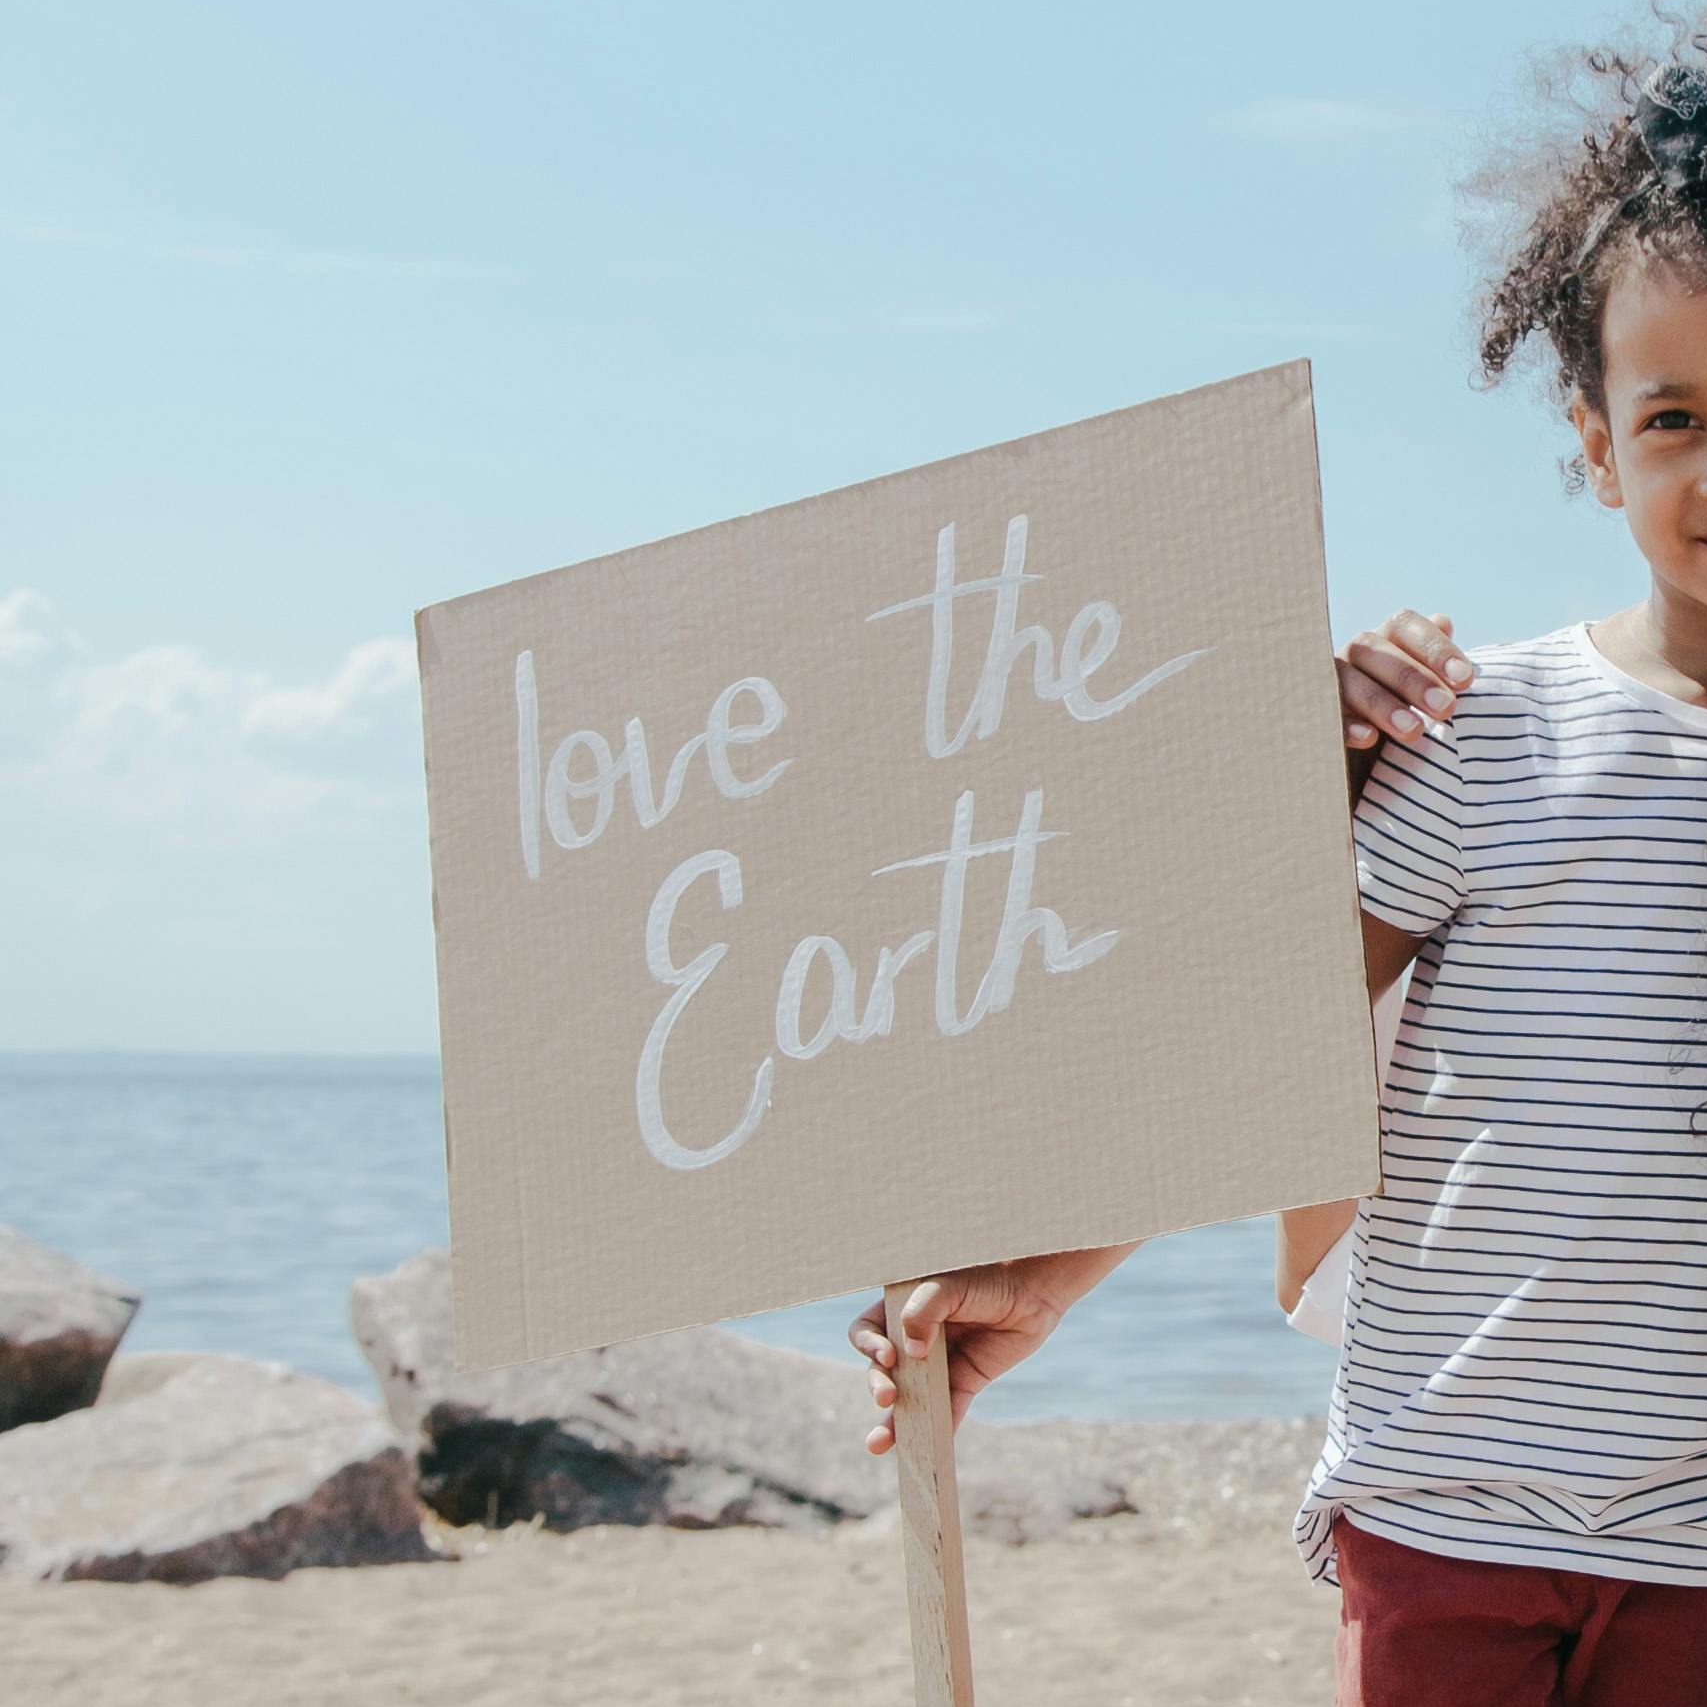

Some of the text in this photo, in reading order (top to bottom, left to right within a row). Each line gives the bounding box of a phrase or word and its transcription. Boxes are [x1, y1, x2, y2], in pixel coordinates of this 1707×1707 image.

[517, 515, 1217, 878] love the
[637, 790, 1117, 1168] Earth
